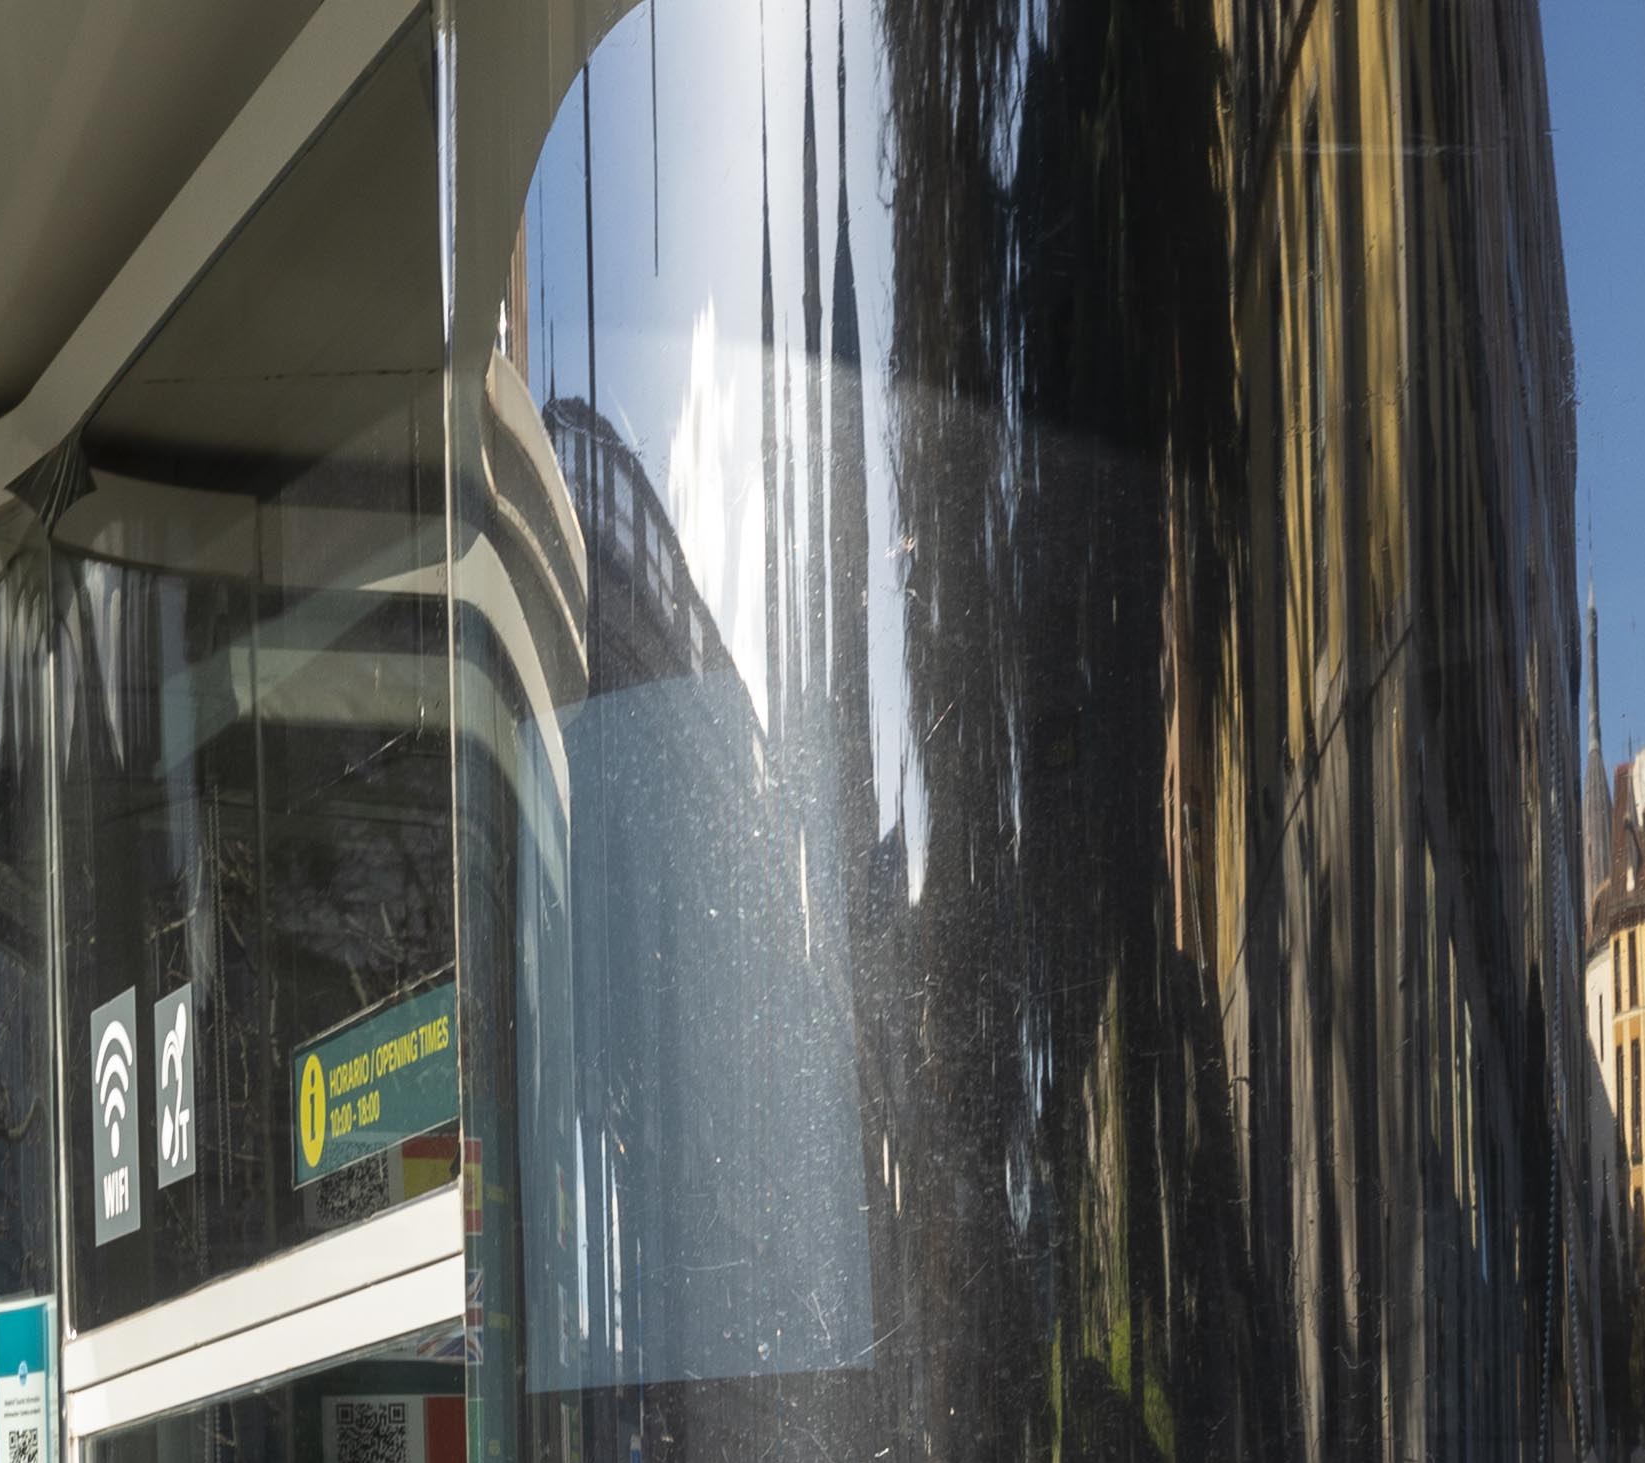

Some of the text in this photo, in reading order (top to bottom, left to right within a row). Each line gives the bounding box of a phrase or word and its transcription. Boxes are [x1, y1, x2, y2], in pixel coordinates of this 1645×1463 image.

[329, 1053, 369, 1099] HORARIO
[376, 1030, 418, 1077] OPENING
[419, 1016, 449, 1058] TIMES
[103, 1166, 129, 1220] WIFI
